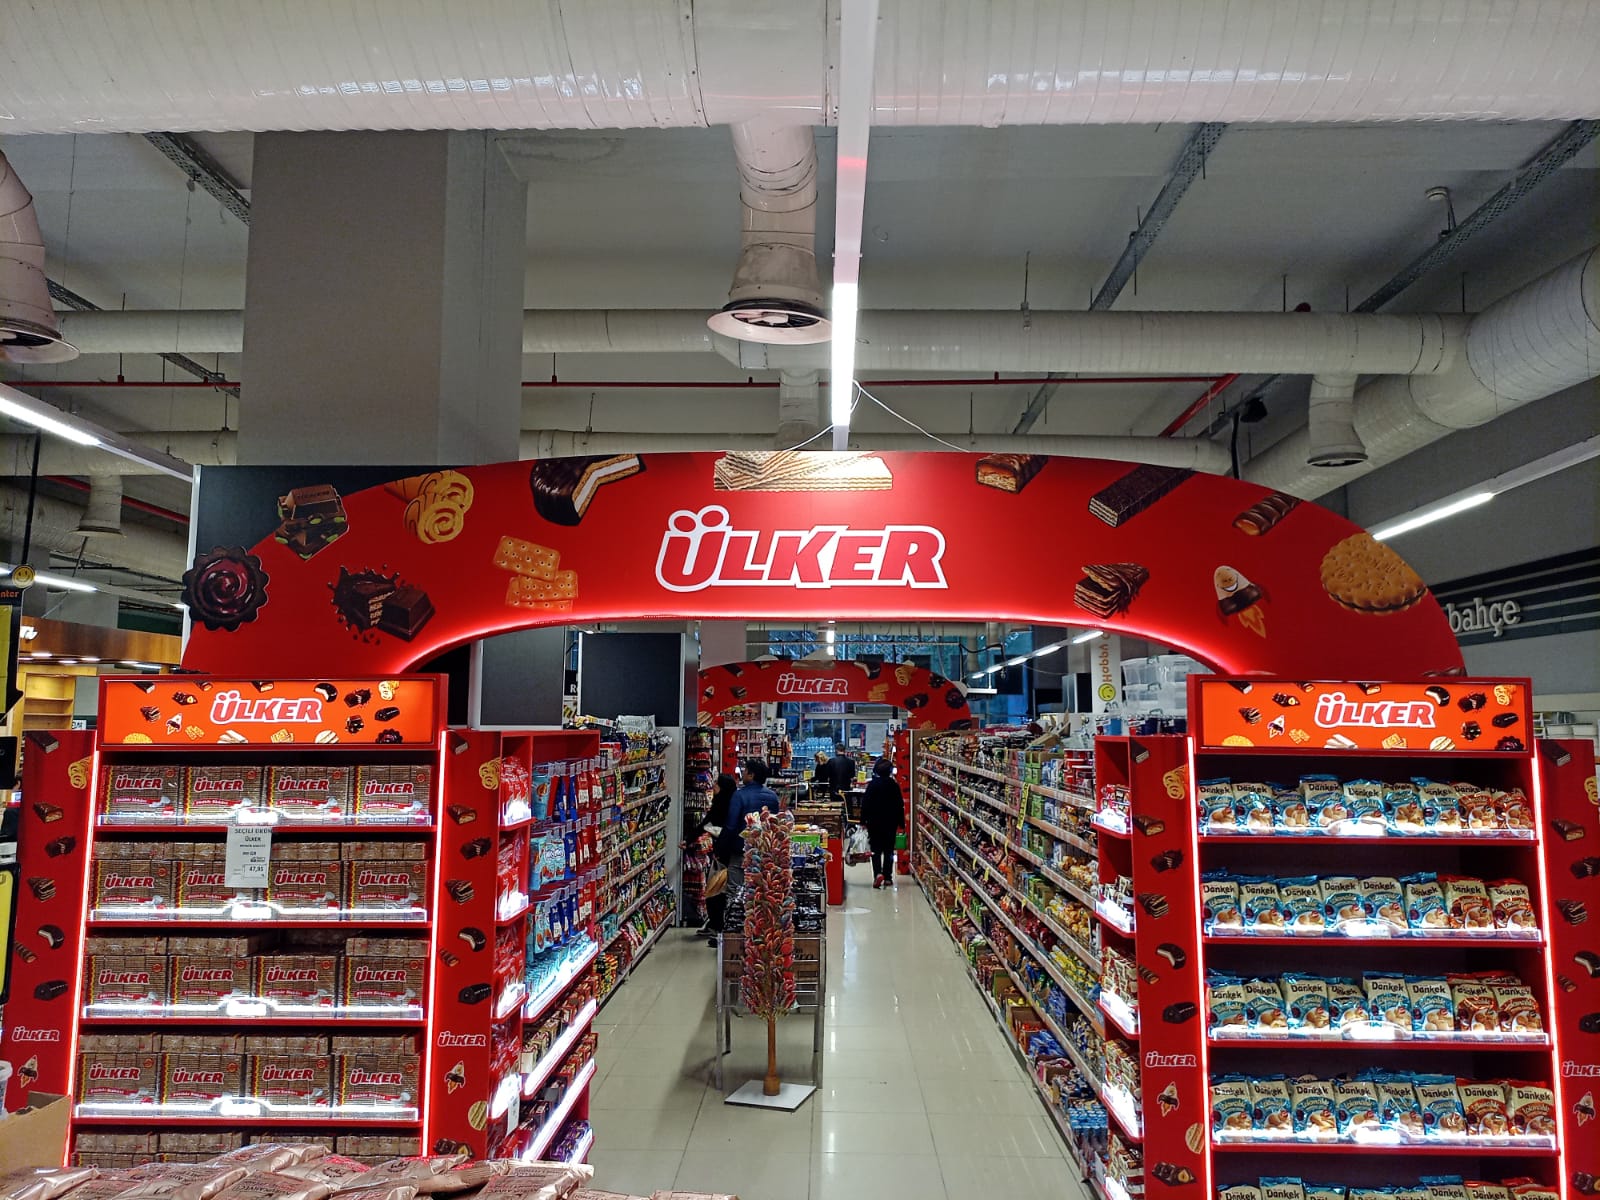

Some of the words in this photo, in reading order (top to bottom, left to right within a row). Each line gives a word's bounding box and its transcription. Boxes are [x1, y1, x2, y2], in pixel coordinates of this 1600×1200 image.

[655, 505, 948, 592] ÜLKER
[1446, 597, 1520, 637] bahçe
[776, 673, 848, 695] ÜLKER
[210, 690, 323, 724] ÜLKER
[1314, 691, 1436, 728] ÜLKER
[115, 774, 163, 790] ÜLKER
[194, 776, 244, 792] ÜLKER
[278, 776, 329, 792] ÜLKER
[365, 780, 414, 796] ÜLKER
[105, 873, 154, 889] ÜLKER
[186, 870, 225, 886] ÜLKE
[275, 869, 326, 886] ÜLKER
[359, 869, 410, 886] ÜLKER
[1363, 881, 1395, 890] Dankek
[1325, 883, 1356, 891] Dankek
[99, 970, 150, 985] ÜLKER
[182, 966, 233, 982] ÜLKER
[266, 965, 319, 983] ÜLKER
[354, 966, 407, 983] ÜLKER
[1372, 982, 1404, 992] Dankek
[1413, 985, 1446, 994] Dankek
[12, 1026, 60, 1041] ÜLKER
[437, 1030, 486, 1047] ÜLKER
[1145, 1051, 1197, 1068] ÜLKER
[89, 1063, 140, 1080] ÜLKER
[172, 1068, 224, 1084] ÜLKER
[262, 1064, 314, 1081] ÜLKER
[350, 1068, 402, 1086] ÜLKER
[1421, 1088, 1454, 1098] Dankek
[1464, 1087, 1499, 1098] Dankek
[1518, 1090, 1550, 1101] Dankek
[1267, 1189, 1299, 1199] Dankek
[1431, 1187, 1464, 1198] Dankek
